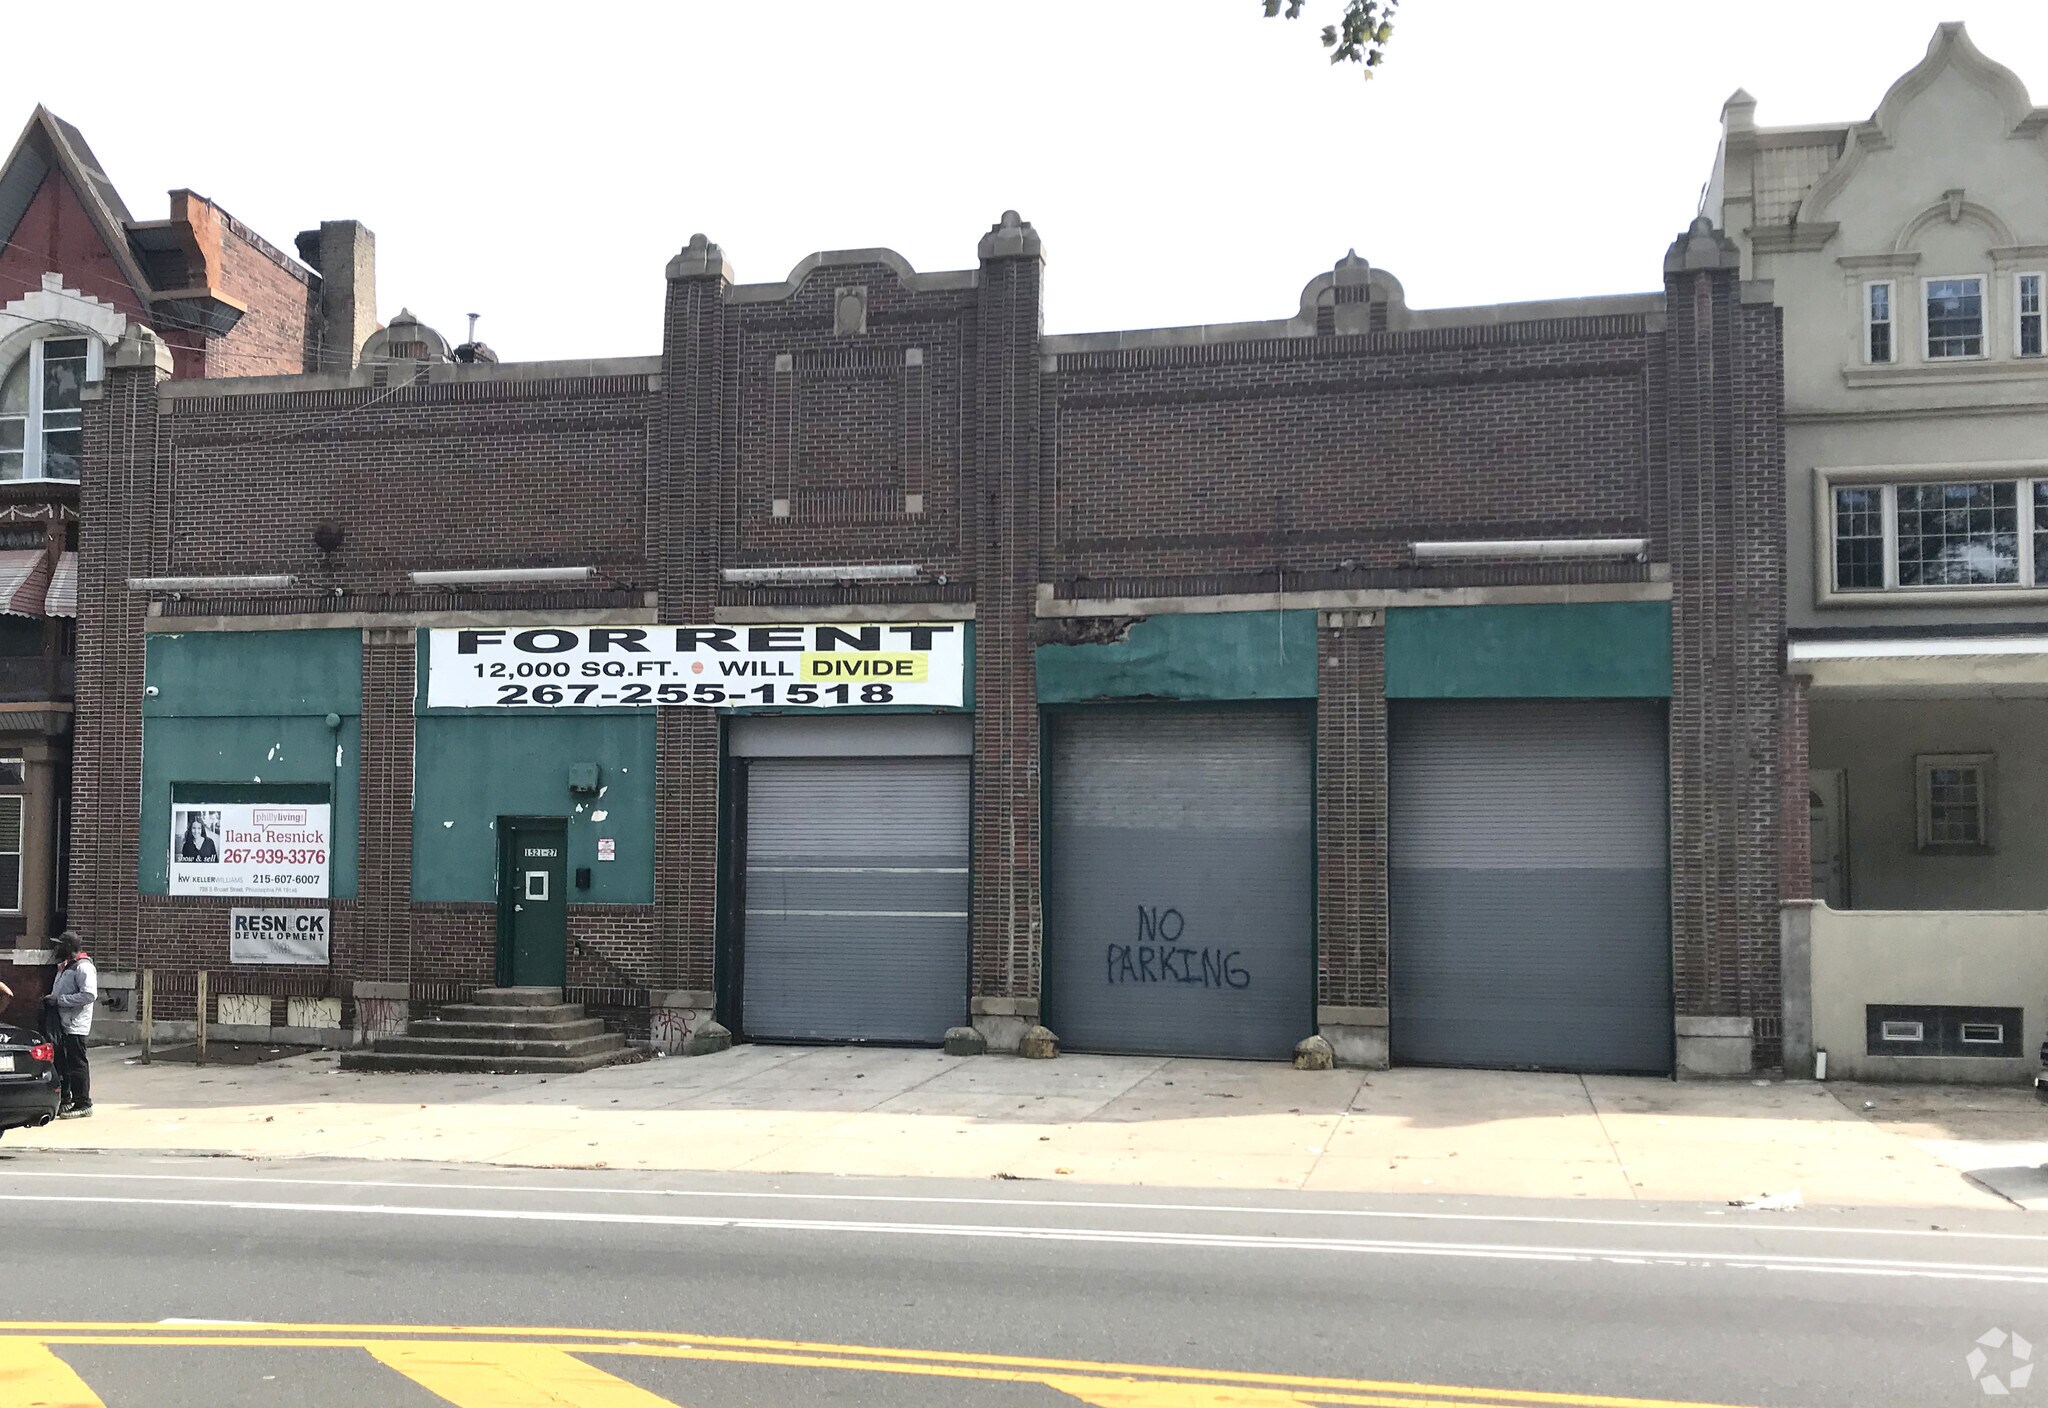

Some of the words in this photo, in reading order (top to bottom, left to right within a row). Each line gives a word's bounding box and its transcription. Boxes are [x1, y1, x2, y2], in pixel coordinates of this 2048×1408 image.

[457, 628, 652, 655] FOR
[676, 626, 954, 652] RENT
[474, 662, 571, 680] 12,000
[581, 661, 679, 677] SQ.FT.
[719, 661, 794, 677] WILL
[812, 660, 914, 676] DIVIDE
[496, 683, 894, 705] 267-255-1518
[225, 830, 261, 843] Ilana
[266, 830, 324, 843] Resnick
[203, 854, 217, 863] sell
[223, 849, 326, 864] 267-939-3376
[252, 874, 320, 885] 215-607-6007
[1138, 904, 1184, 941] NO
[235, 932, 325, 941] DEVELOPMENT
[1107, 943, 1250, 989] PARKING
